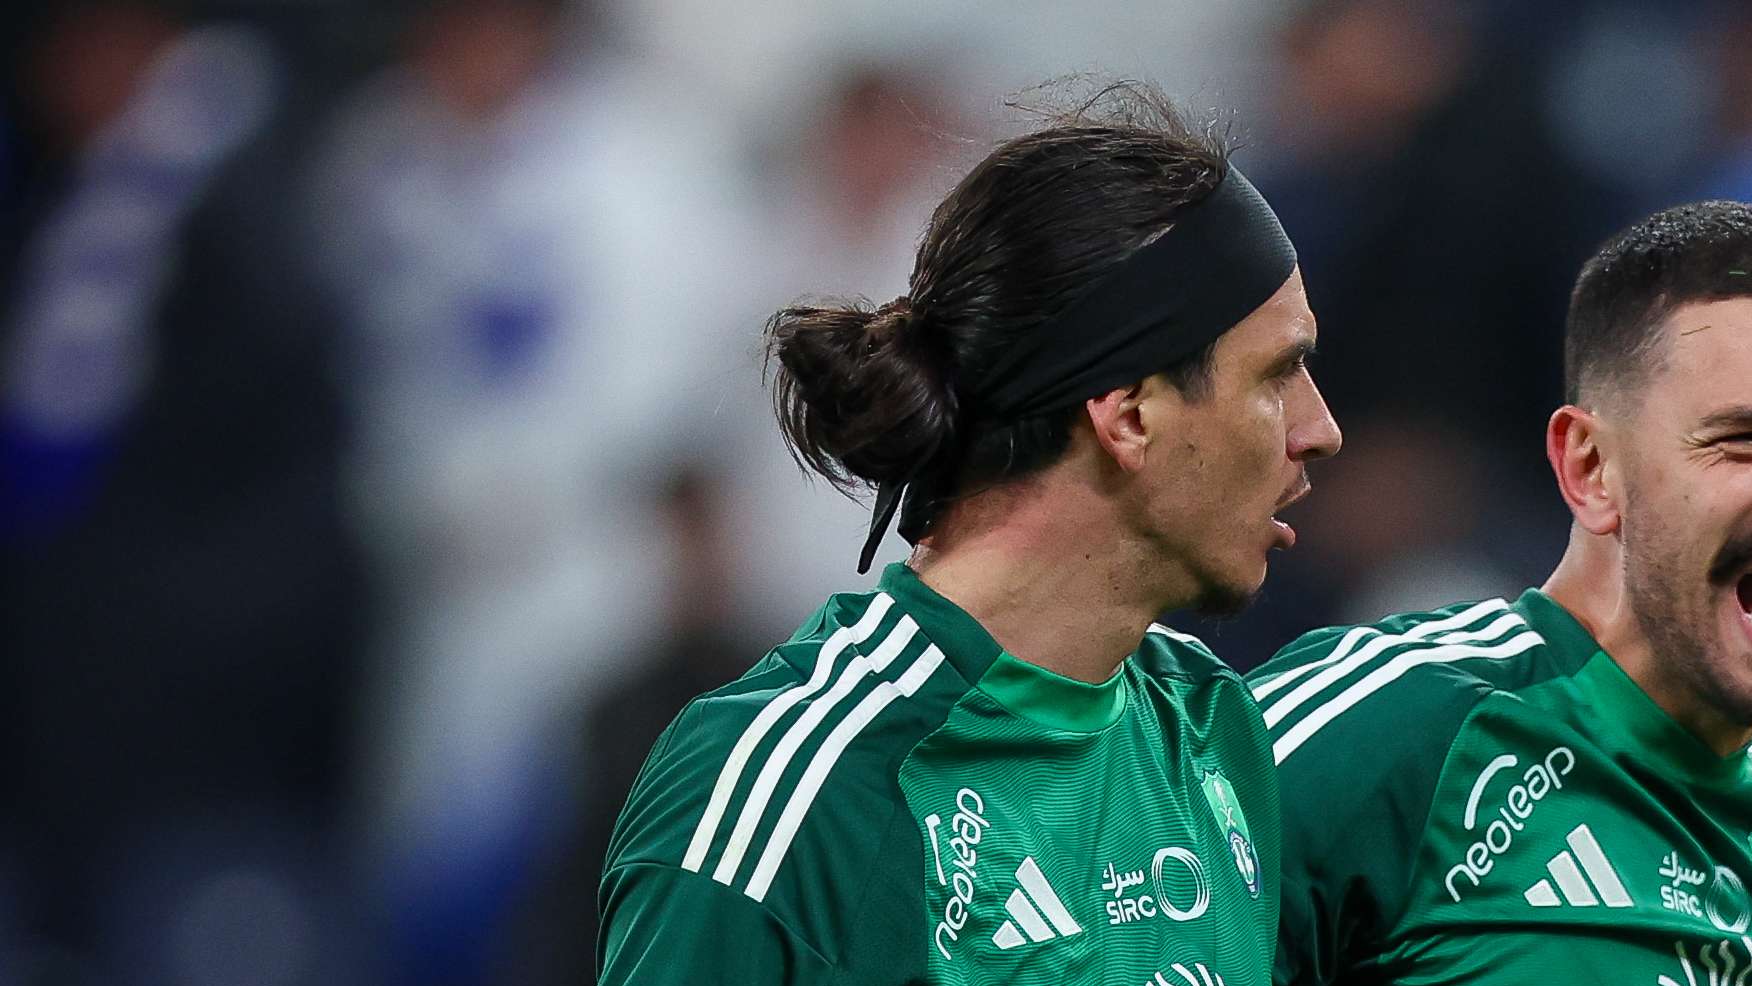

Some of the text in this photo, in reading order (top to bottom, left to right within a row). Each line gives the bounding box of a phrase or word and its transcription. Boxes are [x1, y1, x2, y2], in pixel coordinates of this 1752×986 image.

[1444, 746, 1576, 903] neoleap
[935, 787, 991, 961] neoleap
[1106, 895, 1157, 925] SIRC
[1660, 884, 1704, 918] SIRC
